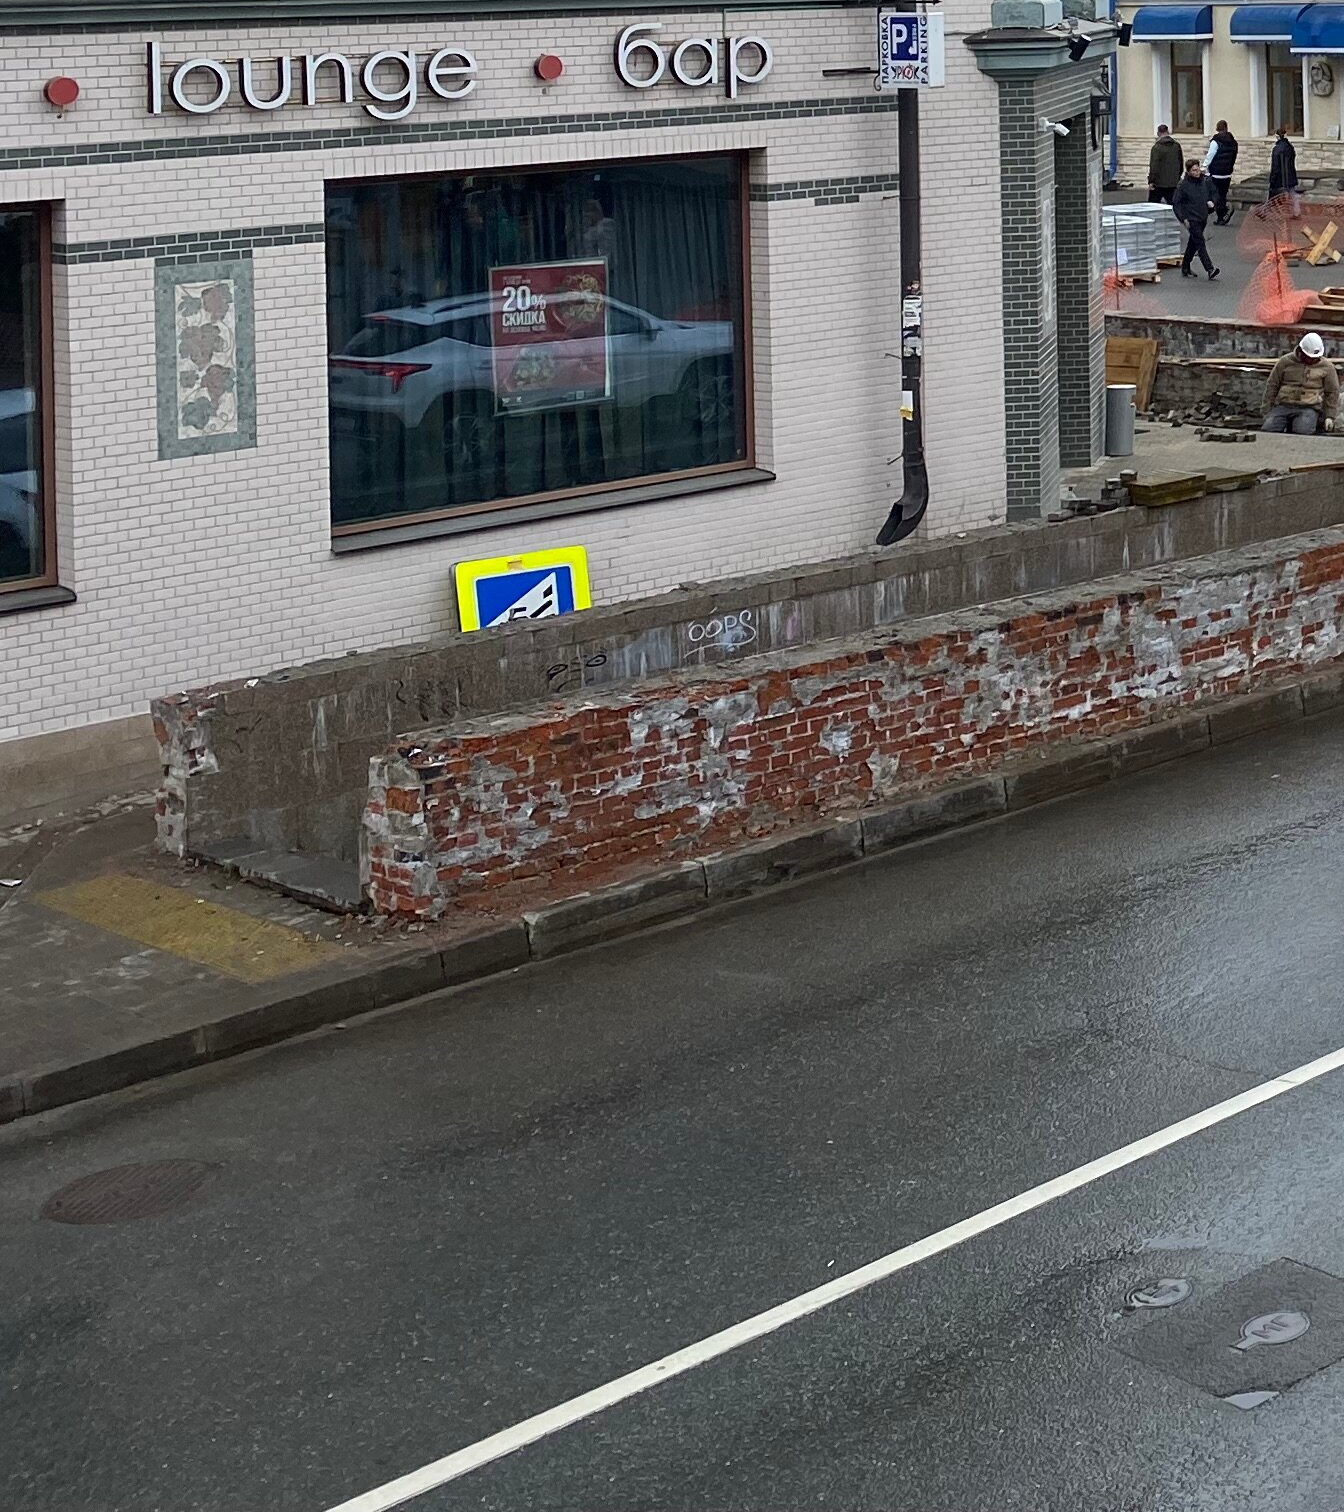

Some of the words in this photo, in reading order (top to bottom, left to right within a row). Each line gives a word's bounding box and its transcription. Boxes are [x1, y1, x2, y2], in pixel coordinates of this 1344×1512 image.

[146, 41, 478, 121] lounge
[615, 22, 774, 99] бар
[881, 16, 889, 84] ПАРКОВКА
[919, 15, 929, 85] PARKING
[502, 285, 547, 313] 20%
[502, 311, 546, 327] СКИДКА
